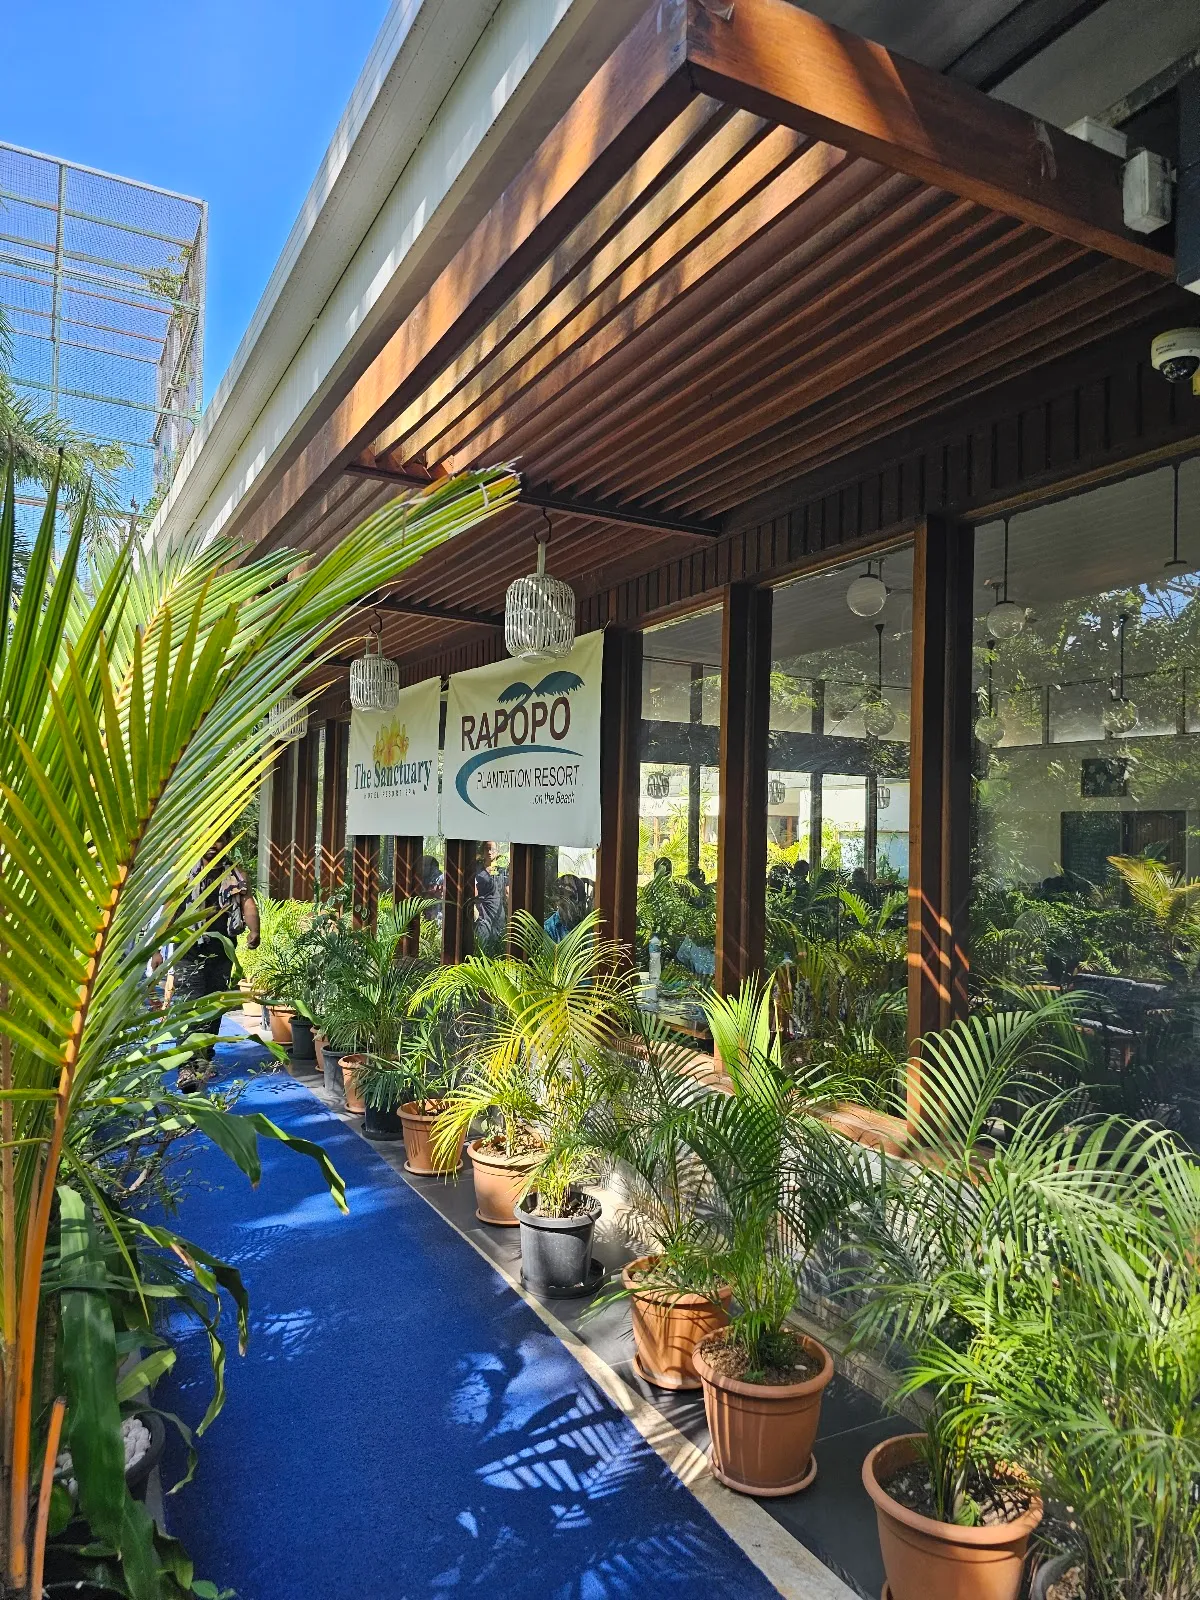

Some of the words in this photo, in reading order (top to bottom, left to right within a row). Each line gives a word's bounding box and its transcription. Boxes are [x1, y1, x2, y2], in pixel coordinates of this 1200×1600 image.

[461, 696, 571, 751] RAPOPO
[354, 763, 372, 790] The
[374, 760, 433, 792] Sanctuary
[476, 768, 532, 789] PLANTATION
[534, 764, 580, 787] RESORT
[544, 791, 554, 804] the
[555, 791, 575, 805] Beach
